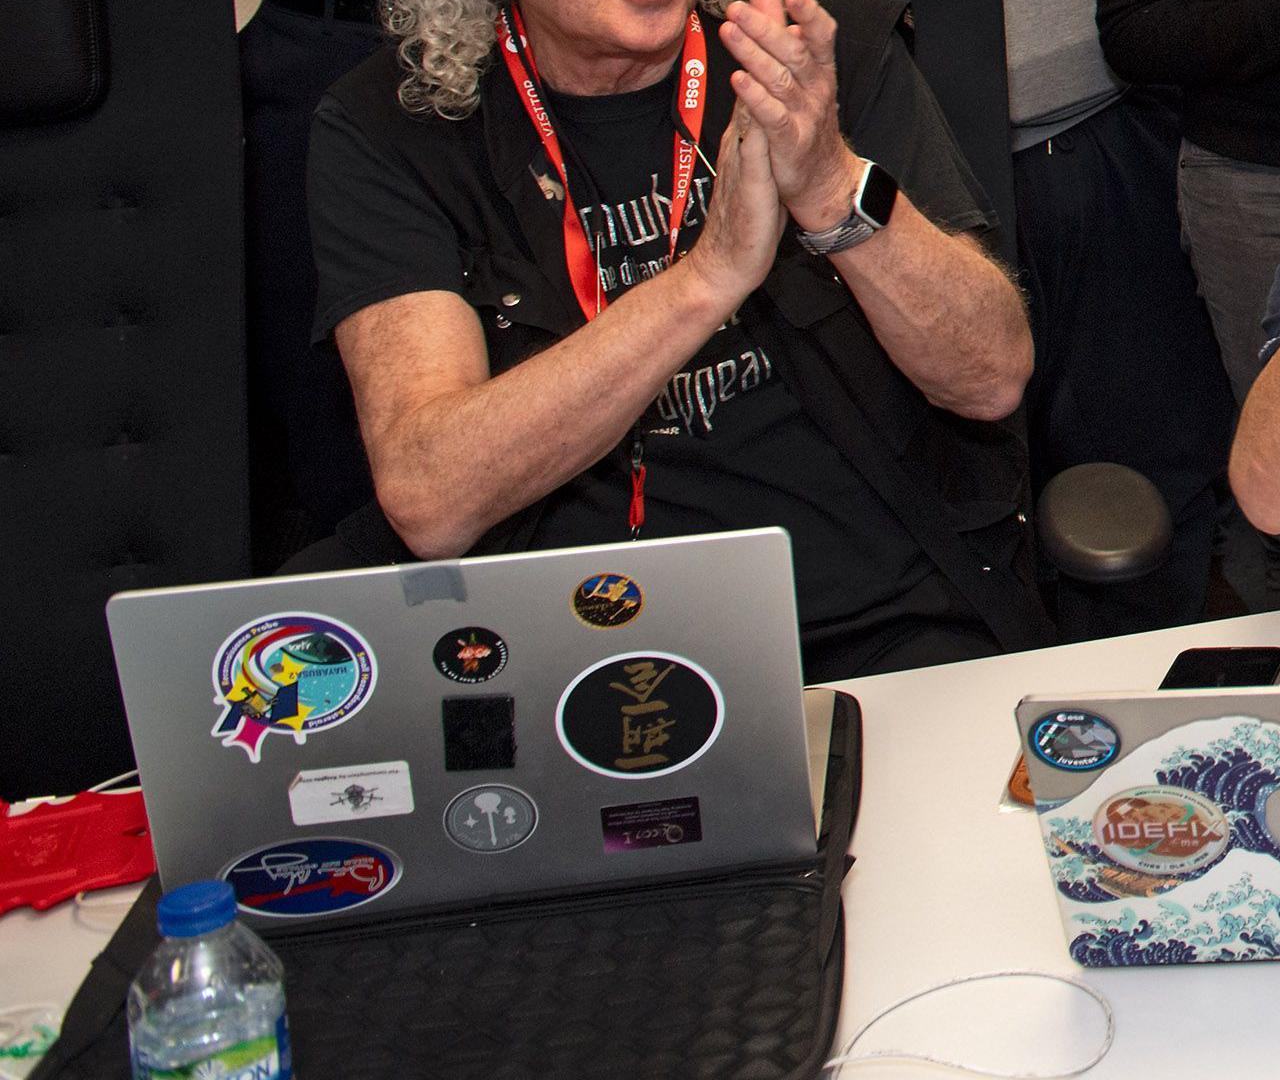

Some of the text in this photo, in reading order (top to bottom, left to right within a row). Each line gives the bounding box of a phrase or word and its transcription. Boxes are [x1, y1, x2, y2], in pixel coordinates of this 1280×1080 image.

[685, 78, 699, 109] esa
[251, 621, 279, 636] Probe
[289, 666, 348, 680] HAYABUSA2
[1108, 820, 1224, 840] IDEFIX
